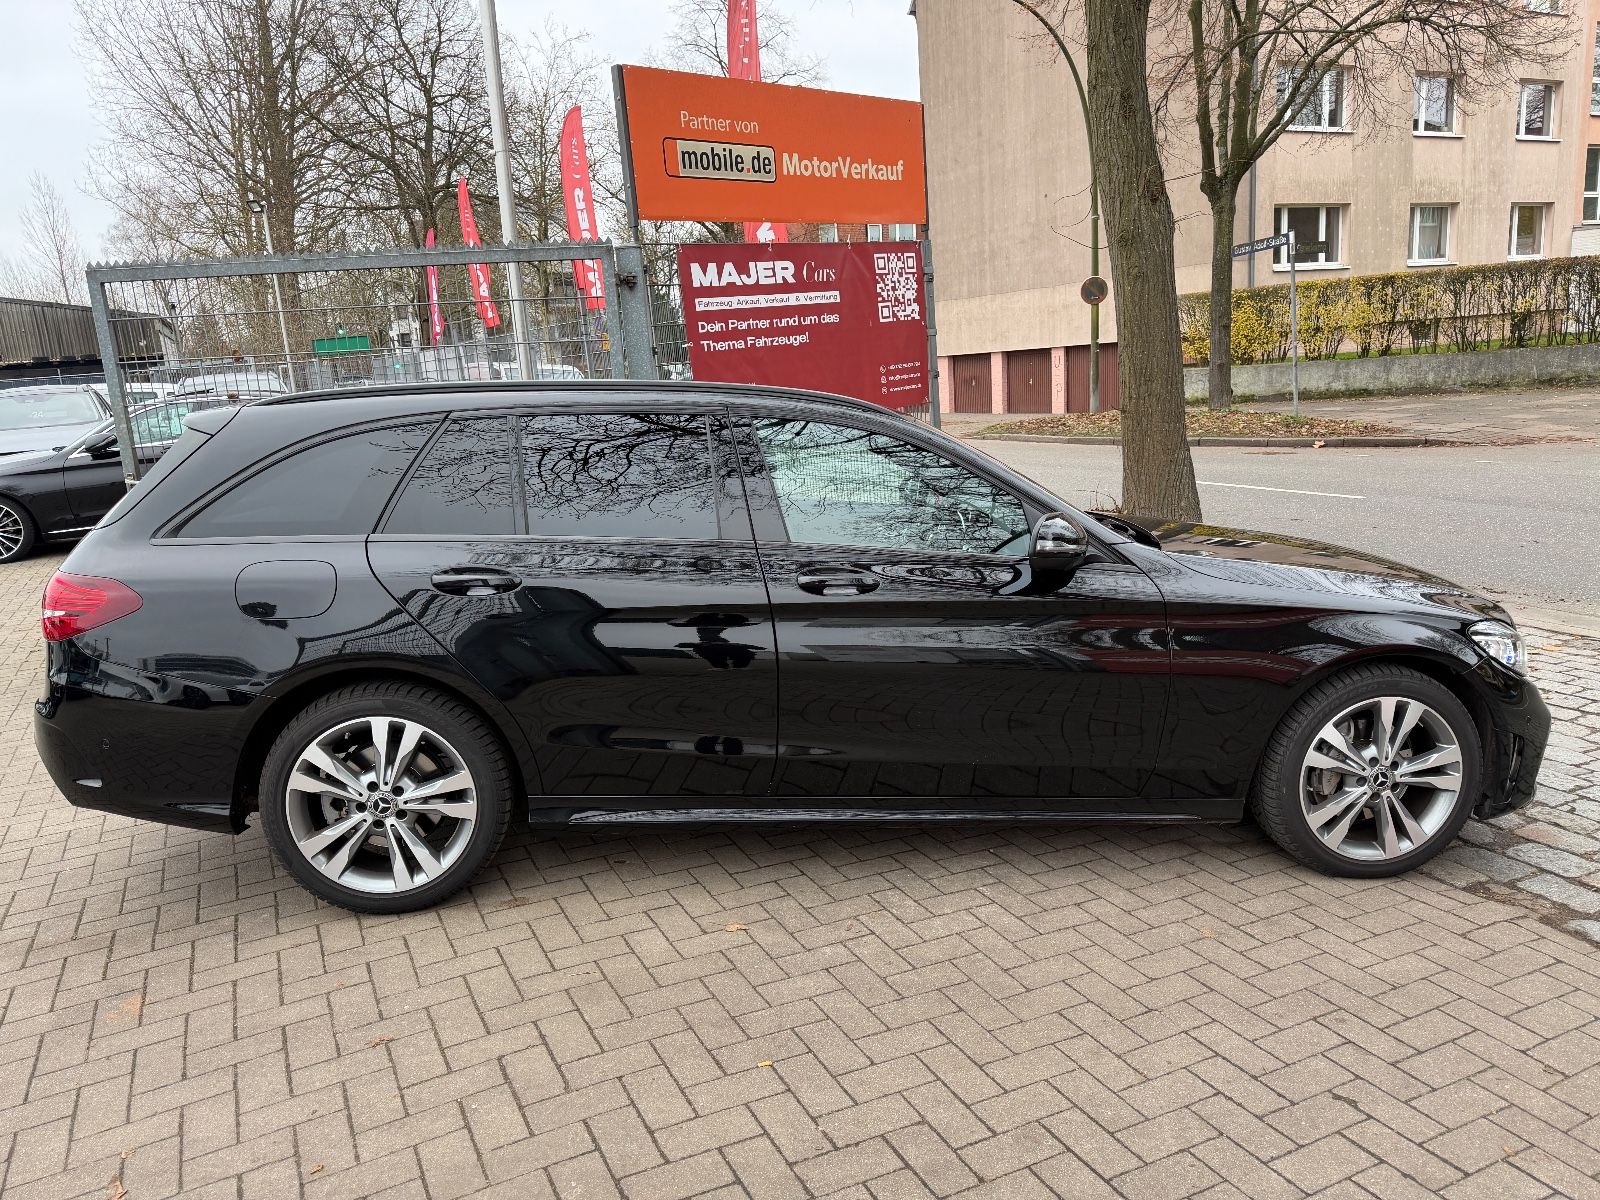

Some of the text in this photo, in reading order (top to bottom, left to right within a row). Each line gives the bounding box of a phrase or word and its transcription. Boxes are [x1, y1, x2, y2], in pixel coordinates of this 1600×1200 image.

[680, 110, 759, 134] Partner von
[680, 147, 773, 175] mobile.de
[782, 152, 904, 181] MotorVerkauf
[690, 260, 836, 287] MAJER Cars
[698, 312, 840, 333] Dein Partner rund um das
[700, 331, 810, 352] Thema Fahrzeuge!
